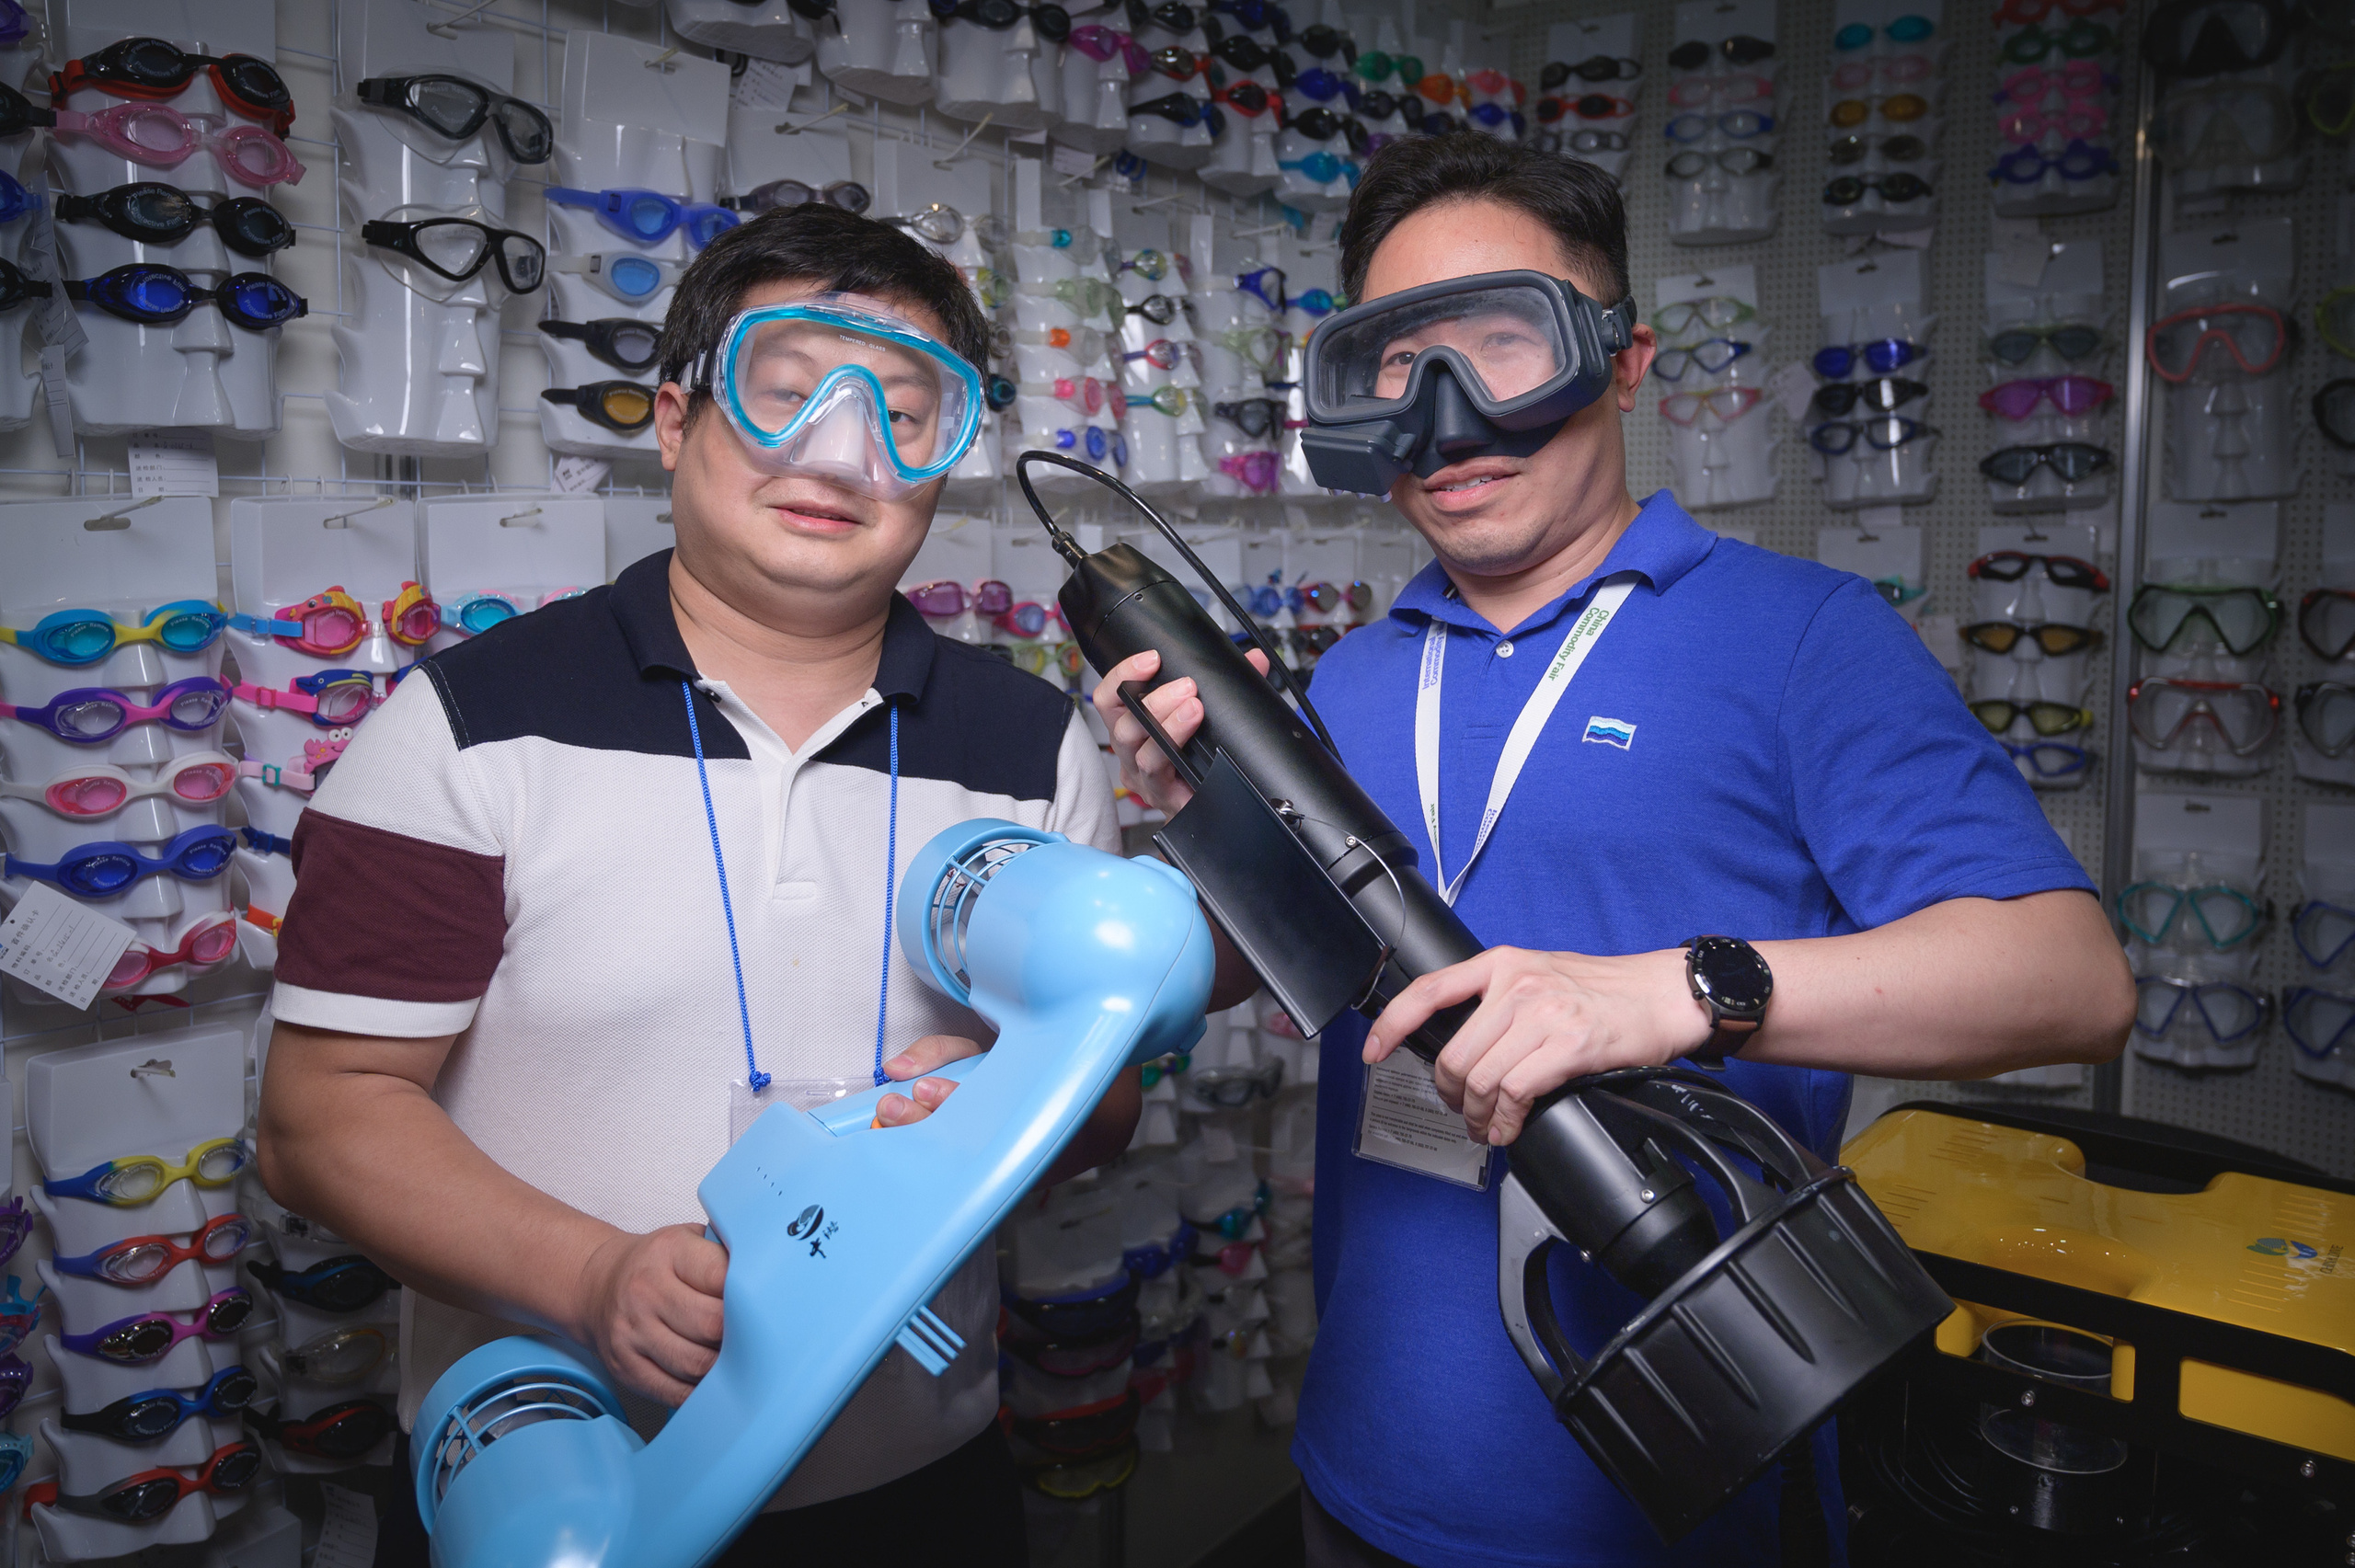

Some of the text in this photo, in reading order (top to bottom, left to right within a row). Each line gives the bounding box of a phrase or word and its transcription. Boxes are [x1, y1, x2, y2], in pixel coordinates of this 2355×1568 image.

[131, 40, 180, 57] Please Remove
[134, 61, 184, 77] Protective Film
[132, 189, 155, 199] Please
[132, 206, 182, 228] Protective Film
[243, 206, 283, 225] Please Remove
[243, 224, 284, 245] Protective Film
[246, 281, 287, 302] Please Remove
[245, 299, 288, 320] Protective Film
[839, 334, 886, 352] TEMPERED GLASS
[169, 616, 210, 629] Please Remove
[336, 610, 354, 624] Remove
[1586, 610, 1610, 636] China
[70, 623, 109, 637] Please Remove
[1548, 607, 1600, 681] Commodity Fair
[1422, 635, 1437, 691] International
[1430, 635, 1445, 686] Commodity
[179, 697, 199, 707] Please
[103, 780, 121, 793] Remove
[189, 843, 228, 856] Please Remove
[91, 855, 131, 869] Please Remove
[11, 910, 40, 945] 首件确认卡
